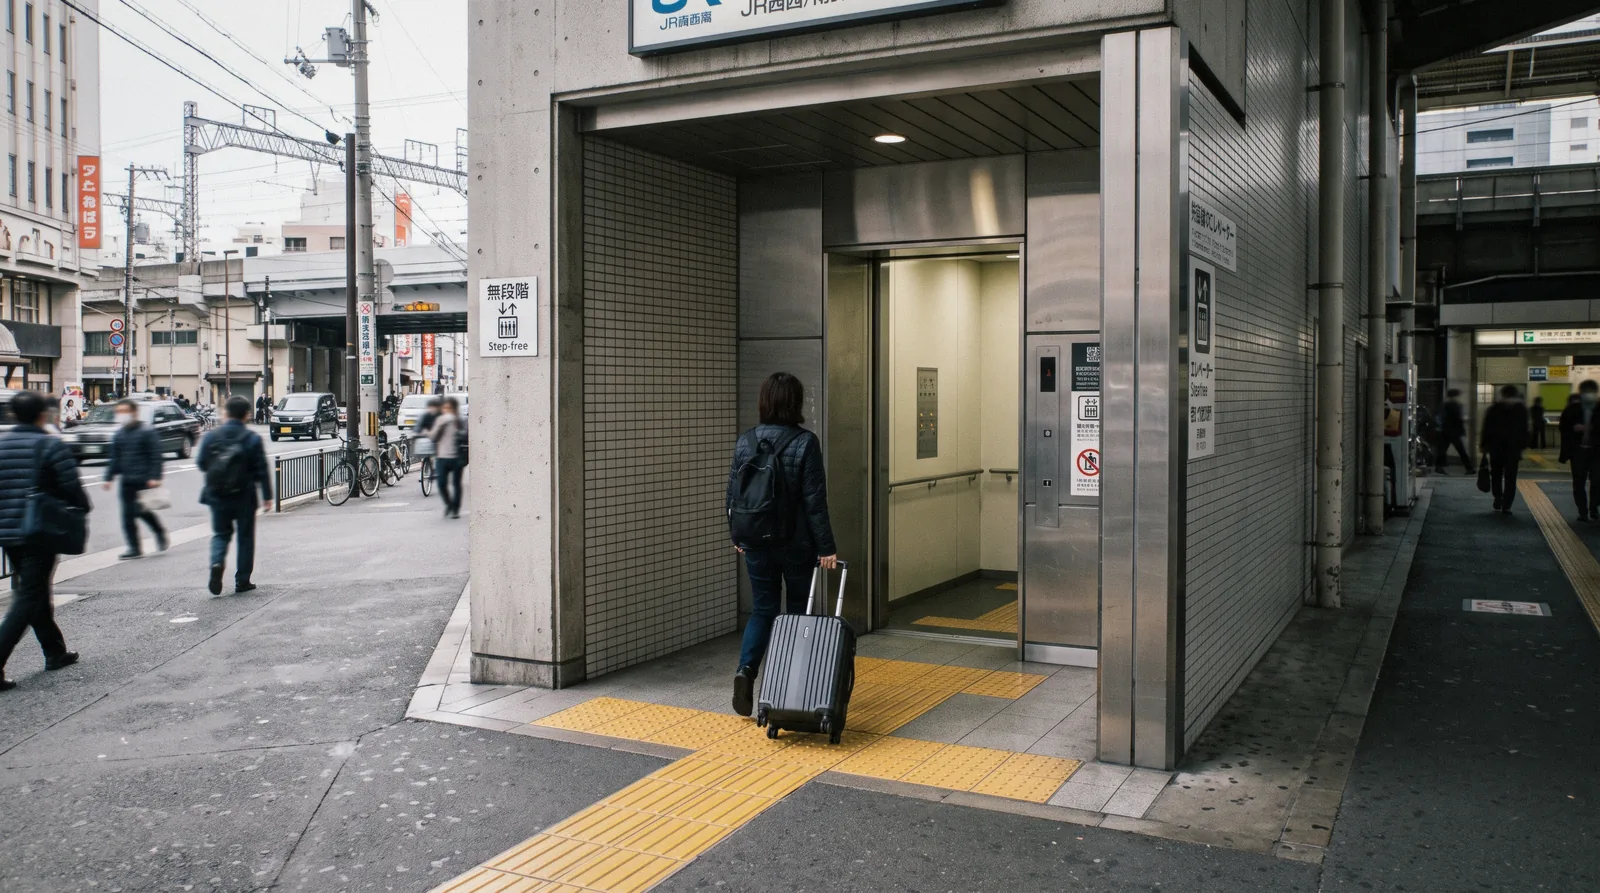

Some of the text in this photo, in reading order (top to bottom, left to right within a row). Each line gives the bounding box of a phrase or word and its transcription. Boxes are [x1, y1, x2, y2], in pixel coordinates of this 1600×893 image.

[487, 282, 529, 301] 無段階
[488, 341, 529, 353] Step-free
